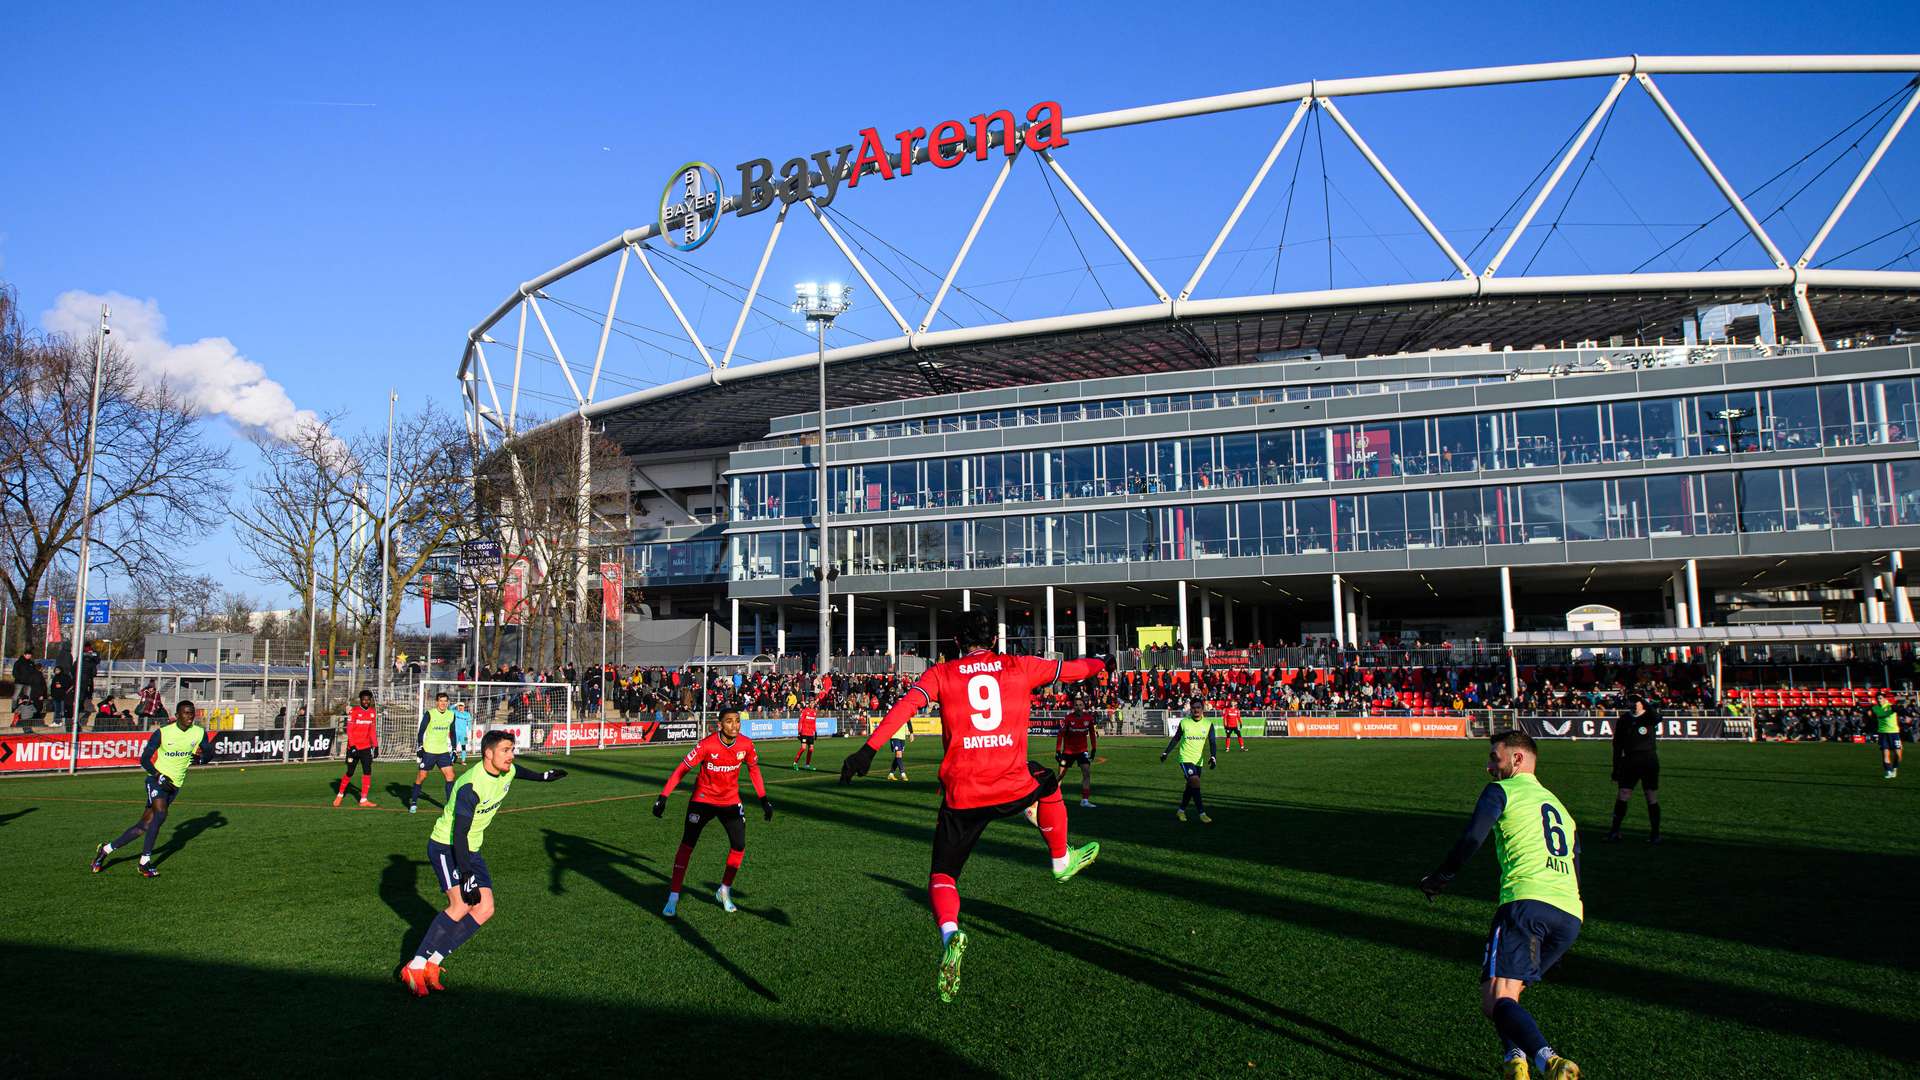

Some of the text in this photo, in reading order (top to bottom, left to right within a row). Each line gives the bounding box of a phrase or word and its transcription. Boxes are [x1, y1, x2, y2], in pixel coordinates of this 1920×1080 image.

[736, 100, 1070, 217] BayArena
[664, 191, 716, 220] BAYER
[683, 170, 696, 243] BAYER
[959, 660, 1003, 675] SARDAR
[967, 674, 1003, 732] 9
[552, 728, 615, 741] FUSBALLSCULE
[667, 728, 697, 741] bayer04.de
[1582, 720, 1699, 736] CARE
[15, 739, 148, 762] MITGLEDSCH
[1541, 803, 1568, 857] 6
